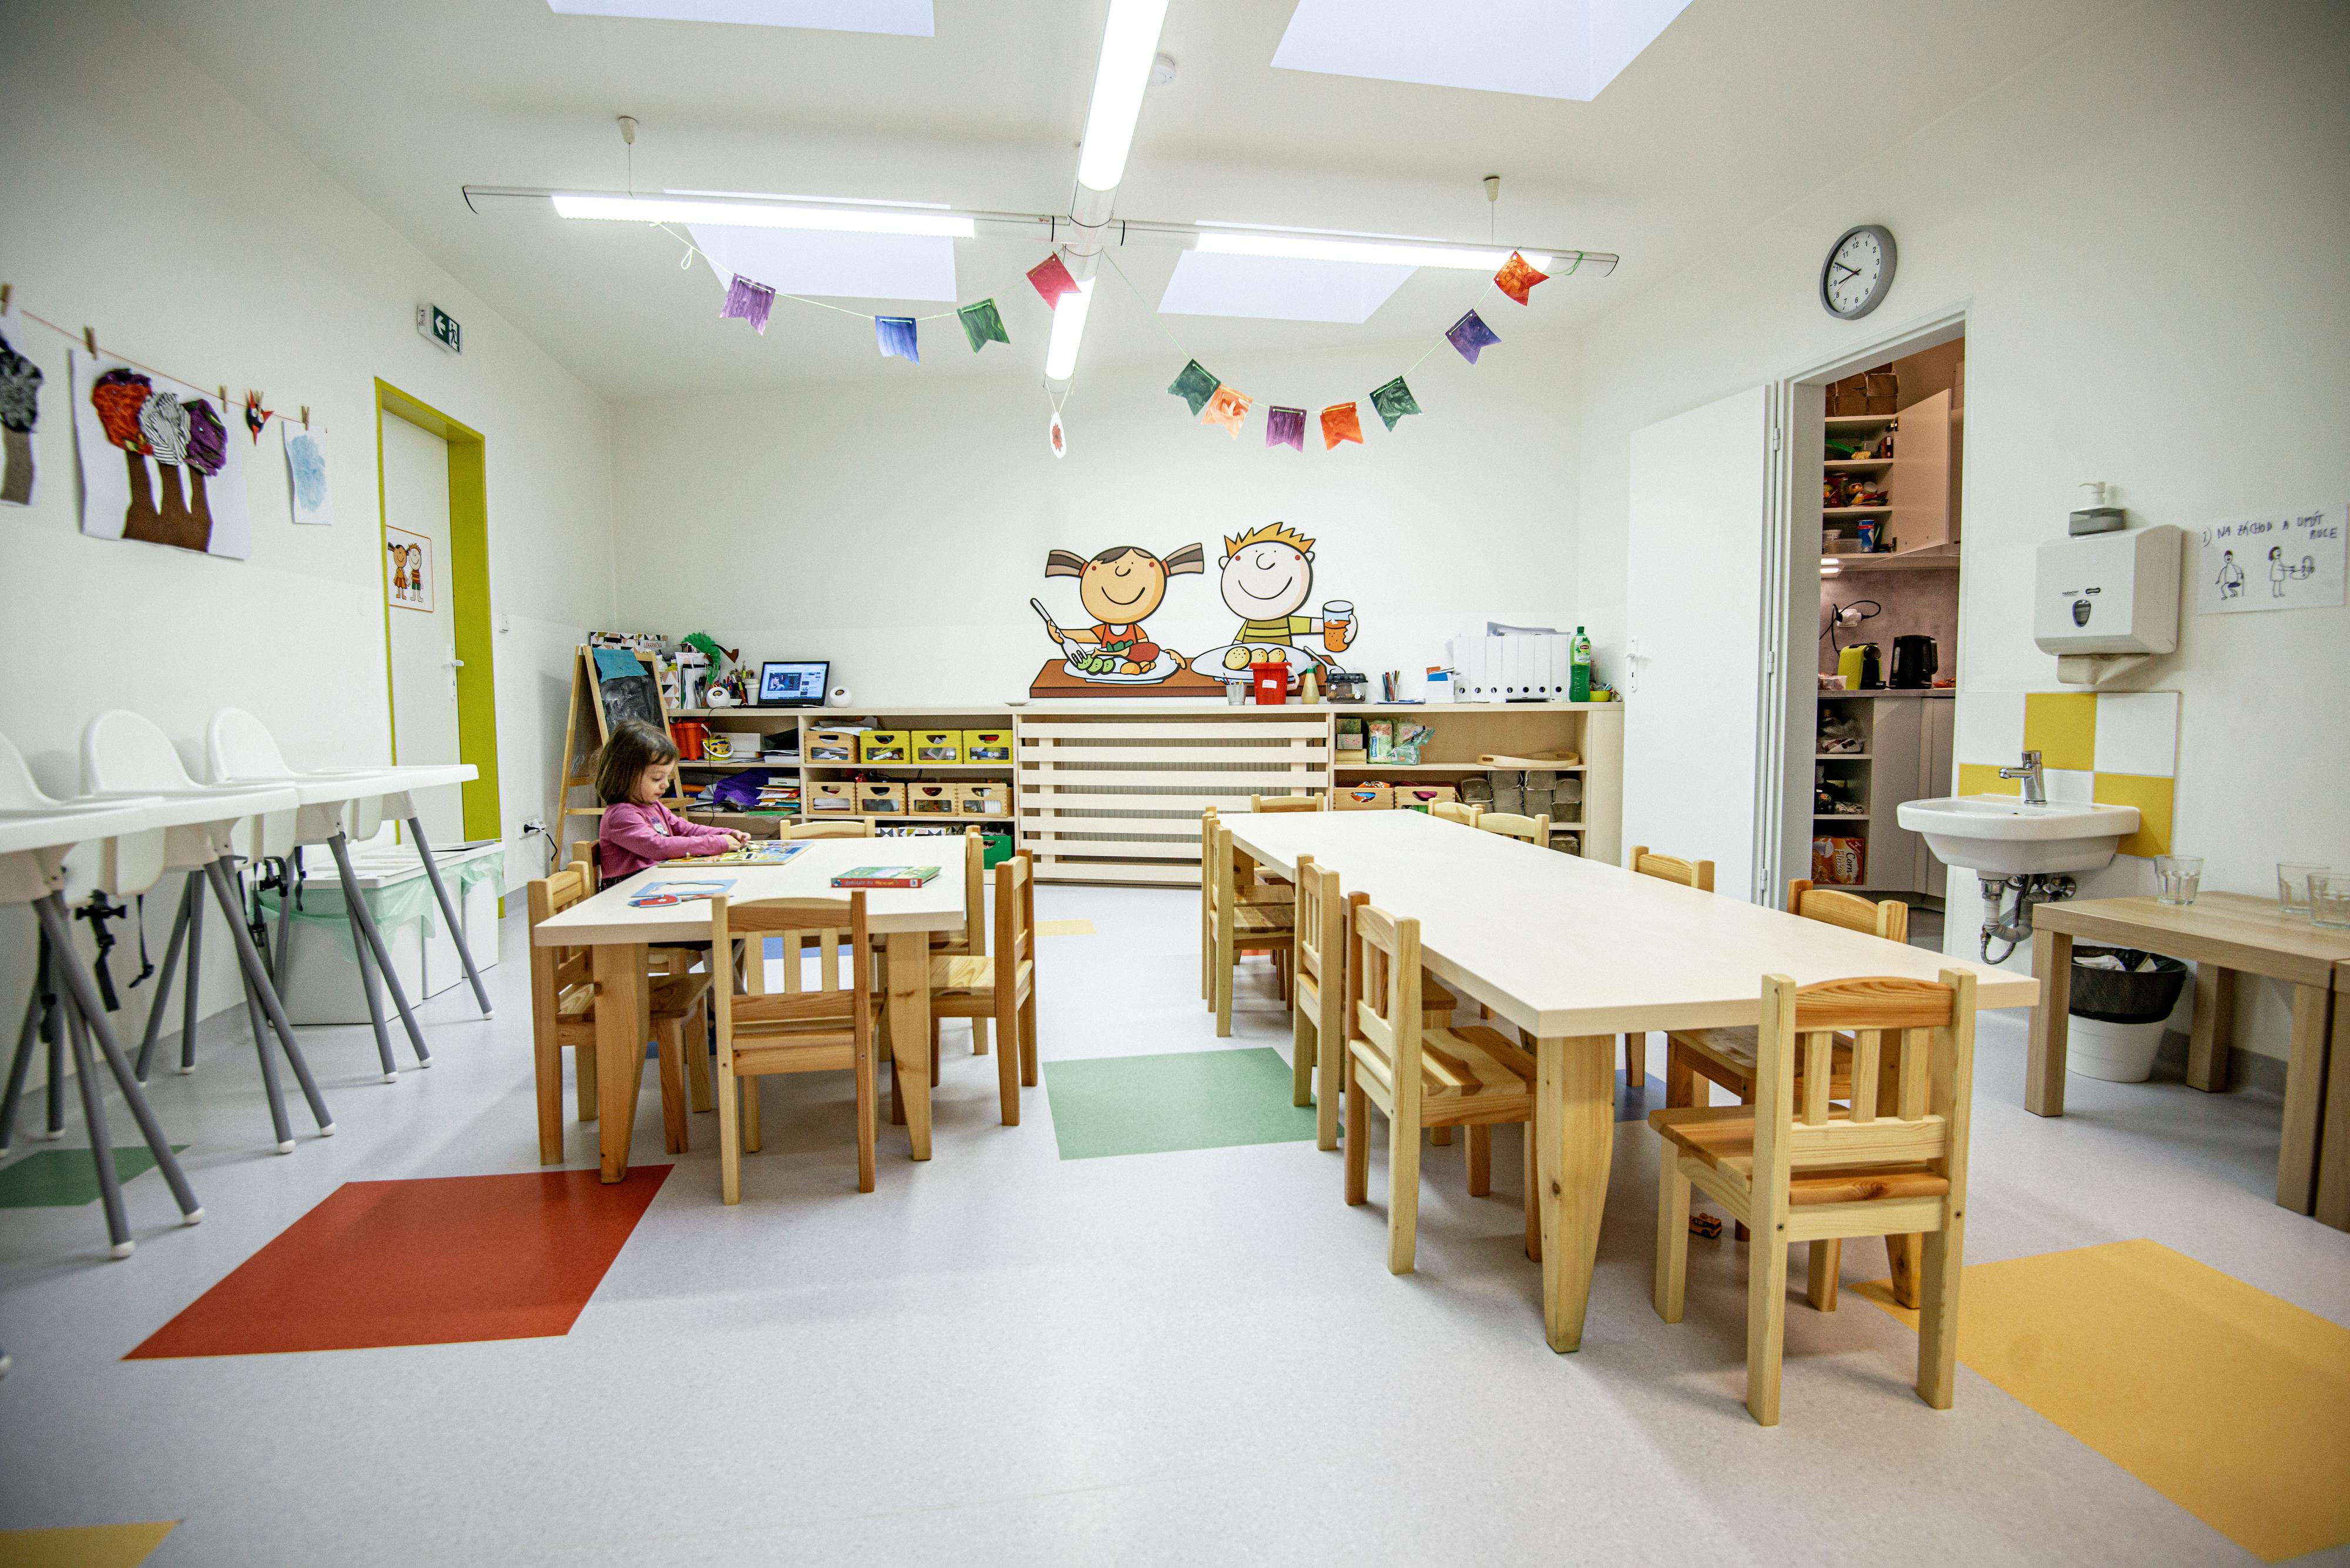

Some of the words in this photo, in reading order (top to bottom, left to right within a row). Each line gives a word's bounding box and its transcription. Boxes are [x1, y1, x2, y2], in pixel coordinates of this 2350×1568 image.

[2217, 526, 2231, 539] NA
[2282, 520, 2289, 530] A
[2309, 527, 2338, 539] RUCE
[1834, 849, 1845, 876] Flakes
[1846, 852, 1855, 874] Corn
